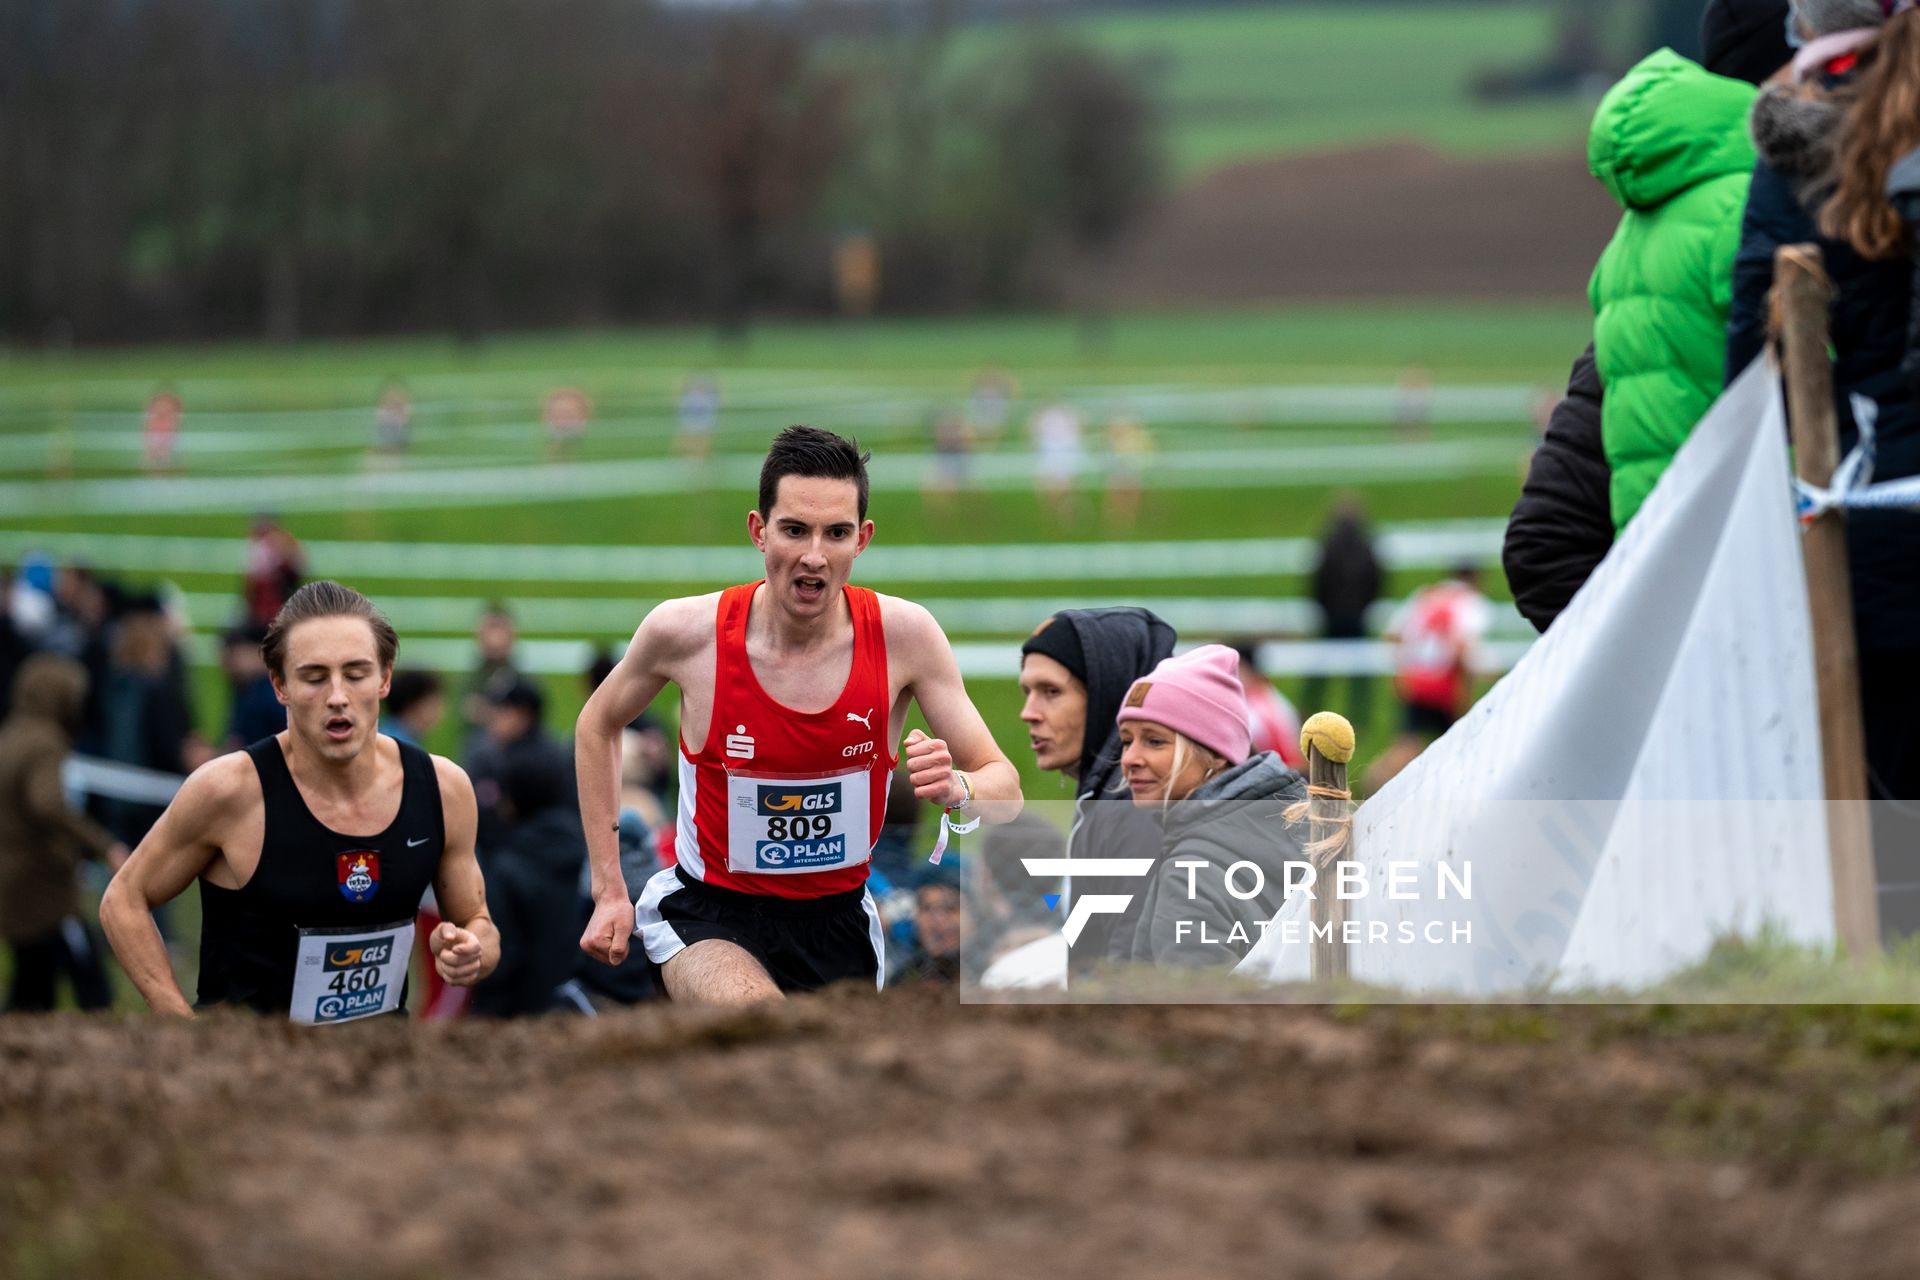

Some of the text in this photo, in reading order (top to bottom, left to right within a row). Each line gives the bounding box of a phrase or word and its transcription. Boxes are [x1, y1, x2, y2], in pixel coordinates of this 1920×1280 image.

[802, 792, 834, 810] GLS
[767, 815, 832, 841] 809
[794, 841, 842, 857] PLAN
[794, 854, 841, 864] INTERNATIONAL
[361, 945, 388, 963] GLS
[328, 967, 380, 995] 460
[346, 990, 383, 1009] PLAN
